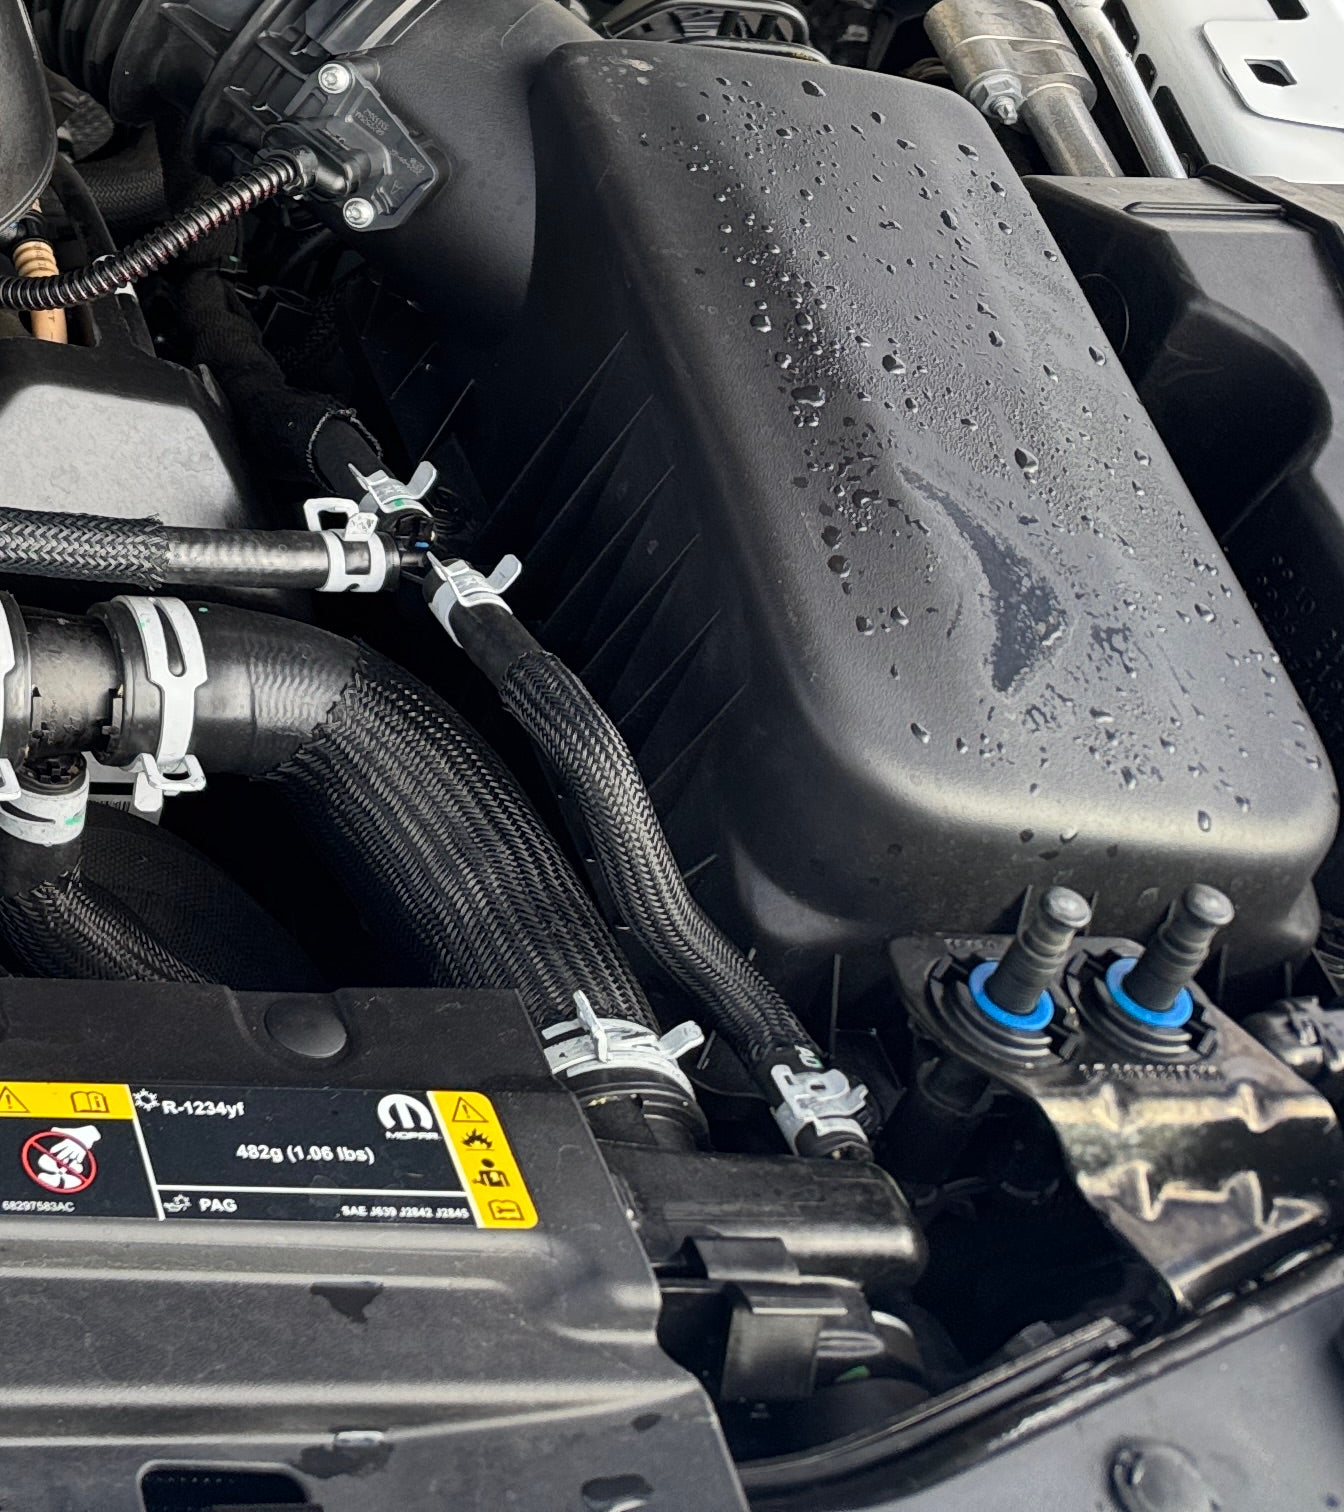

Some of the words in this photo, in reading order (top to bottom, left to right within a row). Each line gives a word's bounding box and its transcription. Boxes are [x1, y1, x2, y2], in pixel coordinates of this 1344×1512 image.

[162, 1100, 245, 1119] R-1234yf
[385, 1131, 440, 1141] MOPAR
[236, 1144, 284, 1164] 482g
[286, 1145, 334, 1164] (1.06
[336, 1146, 375, 1166] lbs)
[198, 1198, 238, 1212] PAG
[340, 1205, 368, 1217] SAE
